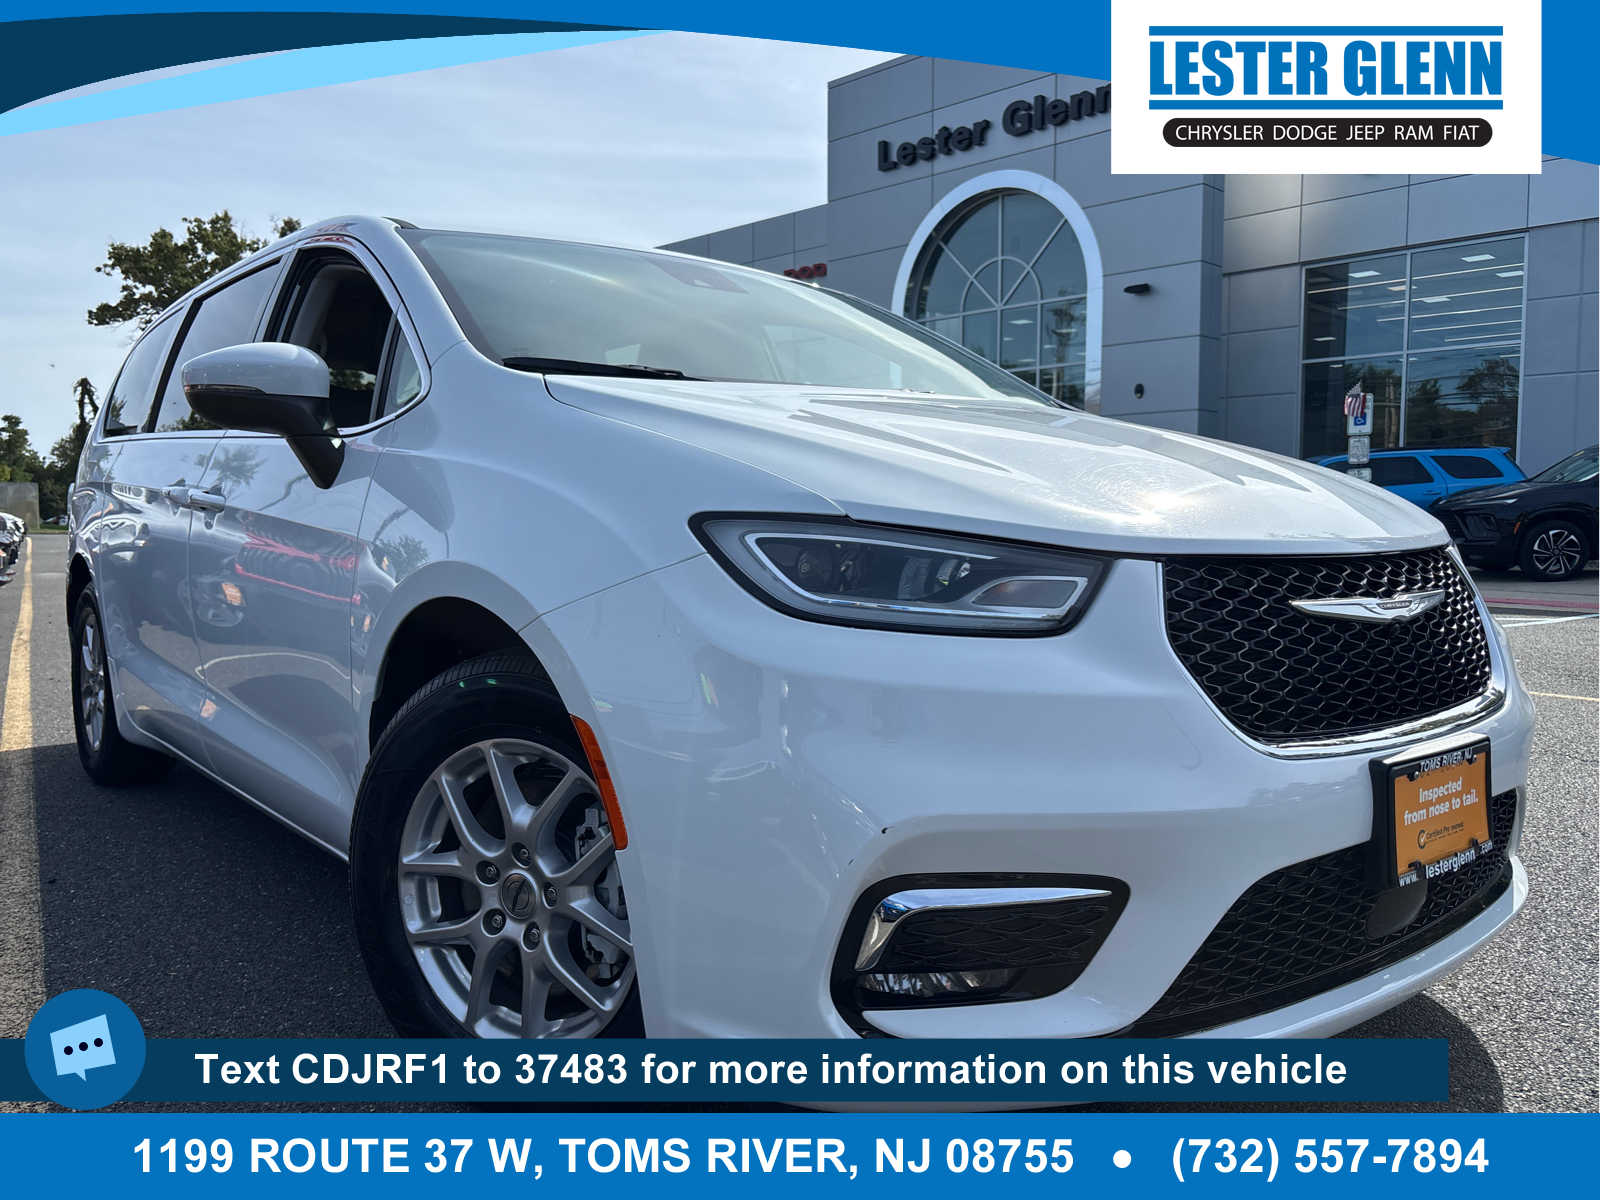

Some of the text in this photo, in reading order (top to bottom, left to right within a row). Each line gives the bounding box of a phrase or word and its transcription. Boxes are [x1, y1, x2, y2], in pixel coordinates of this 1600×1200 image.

[878, 119, 991, 172] Lester
[1420, 757, 1441, 773] TOMS
[1464, 747, 1473, 760] NJ
[1419, 776, 1463, 803] Inspected
[1404, 788, 1478, 826] from nose to tail.
[1425, 849, 1476, 879] lesterglenn
